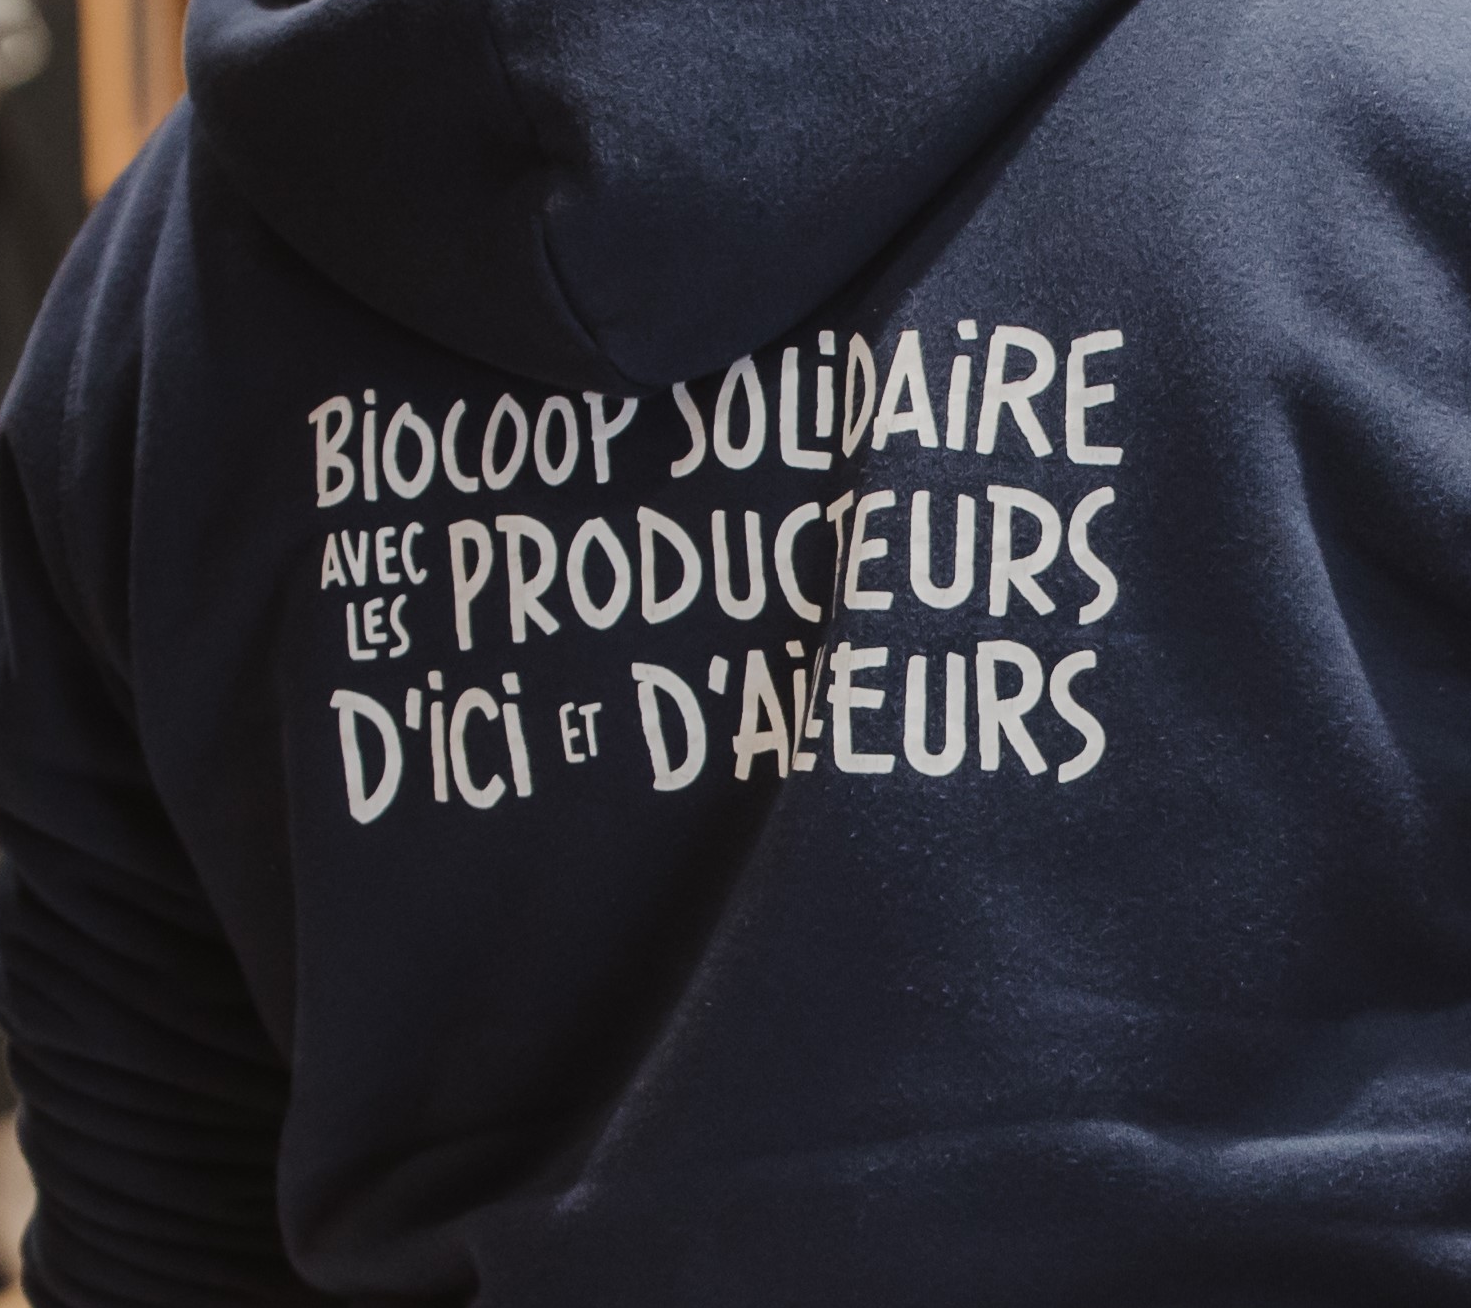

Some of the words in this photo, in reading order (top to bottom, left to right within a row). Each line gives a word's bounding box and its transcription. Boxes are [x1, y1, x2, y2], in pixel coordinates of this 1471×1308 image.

[319, 521, 429, 591] AVEC
[447, 485, 1120, 651] PRODUCTEURS
[345, 591, 411, 662] LES
[558, 701, 603, 765] ET
